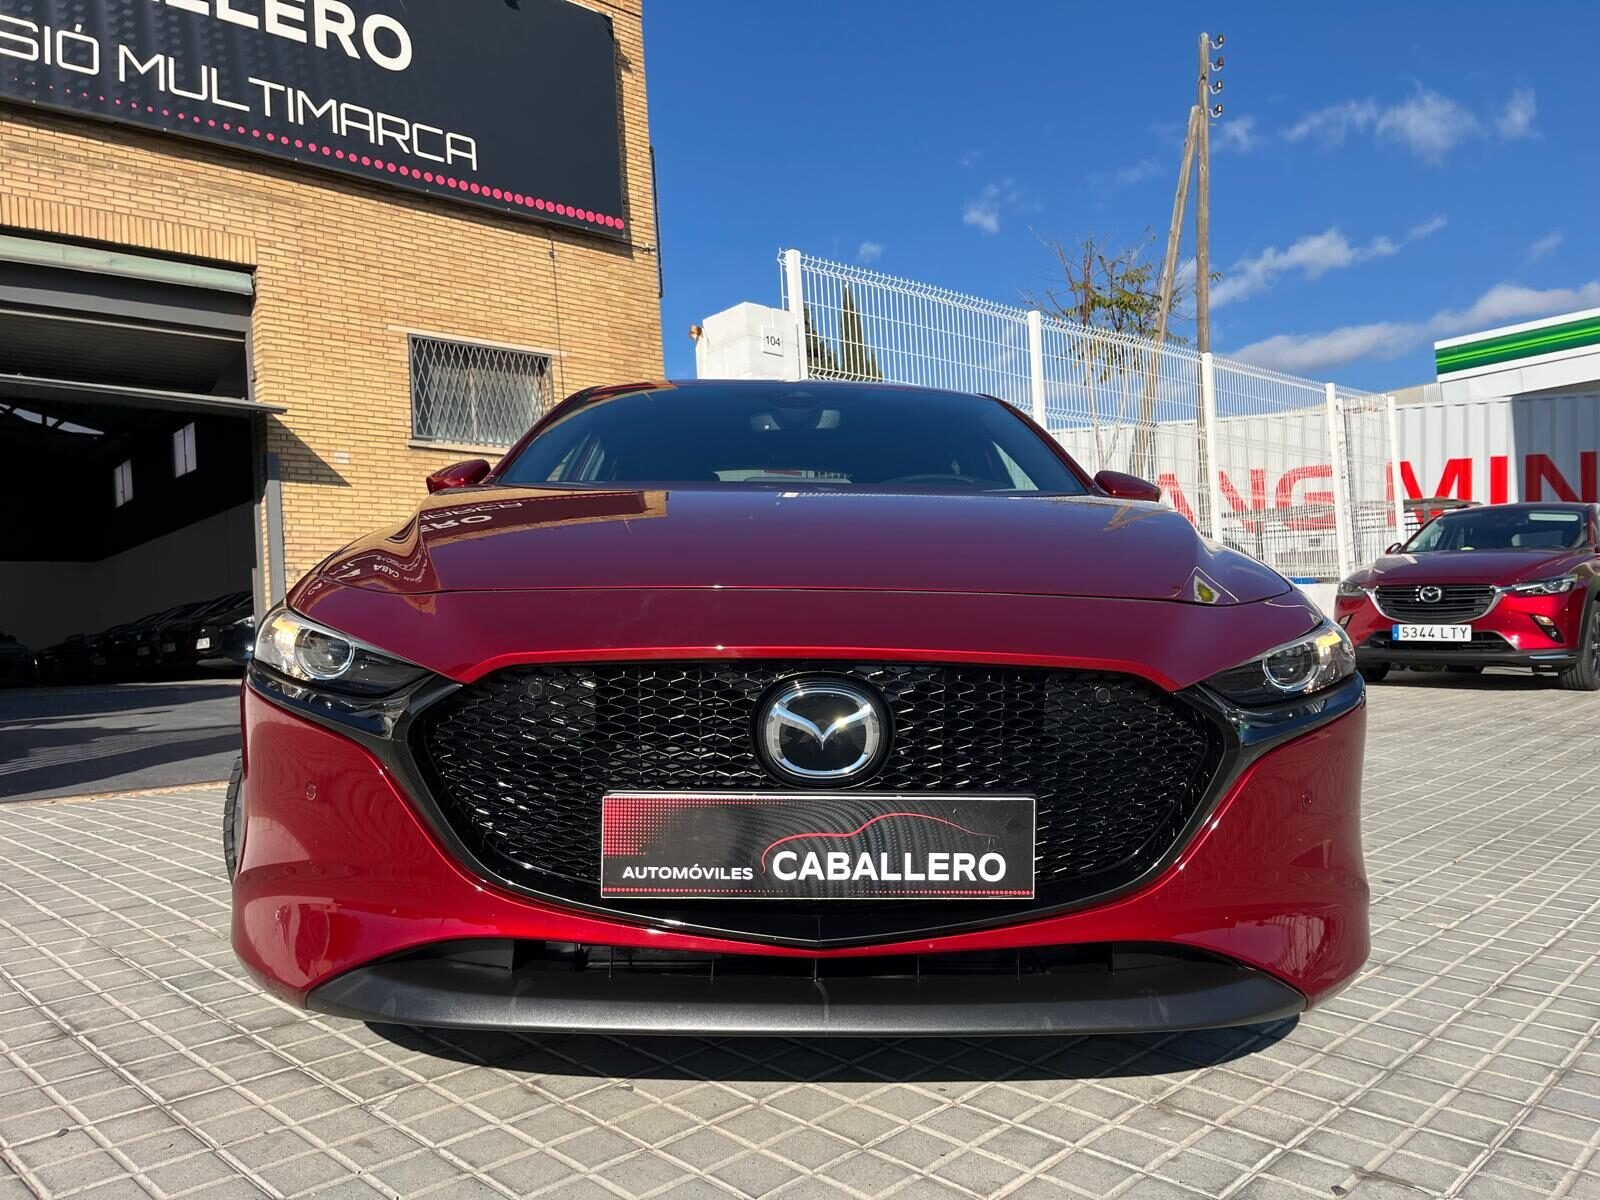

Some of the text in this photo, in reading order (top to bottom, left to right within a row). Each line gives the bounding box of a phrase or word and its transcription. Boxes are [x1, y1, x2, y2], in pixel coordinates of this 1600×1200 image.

[118, 44, 478, 171] MULTIMARCA
[766, 335, 781, 347] 104
[1402, 627, 1468, 639] 5344 LTY
[622, 851, 1007, 882] AUTOMÓVILES CABALLERO
